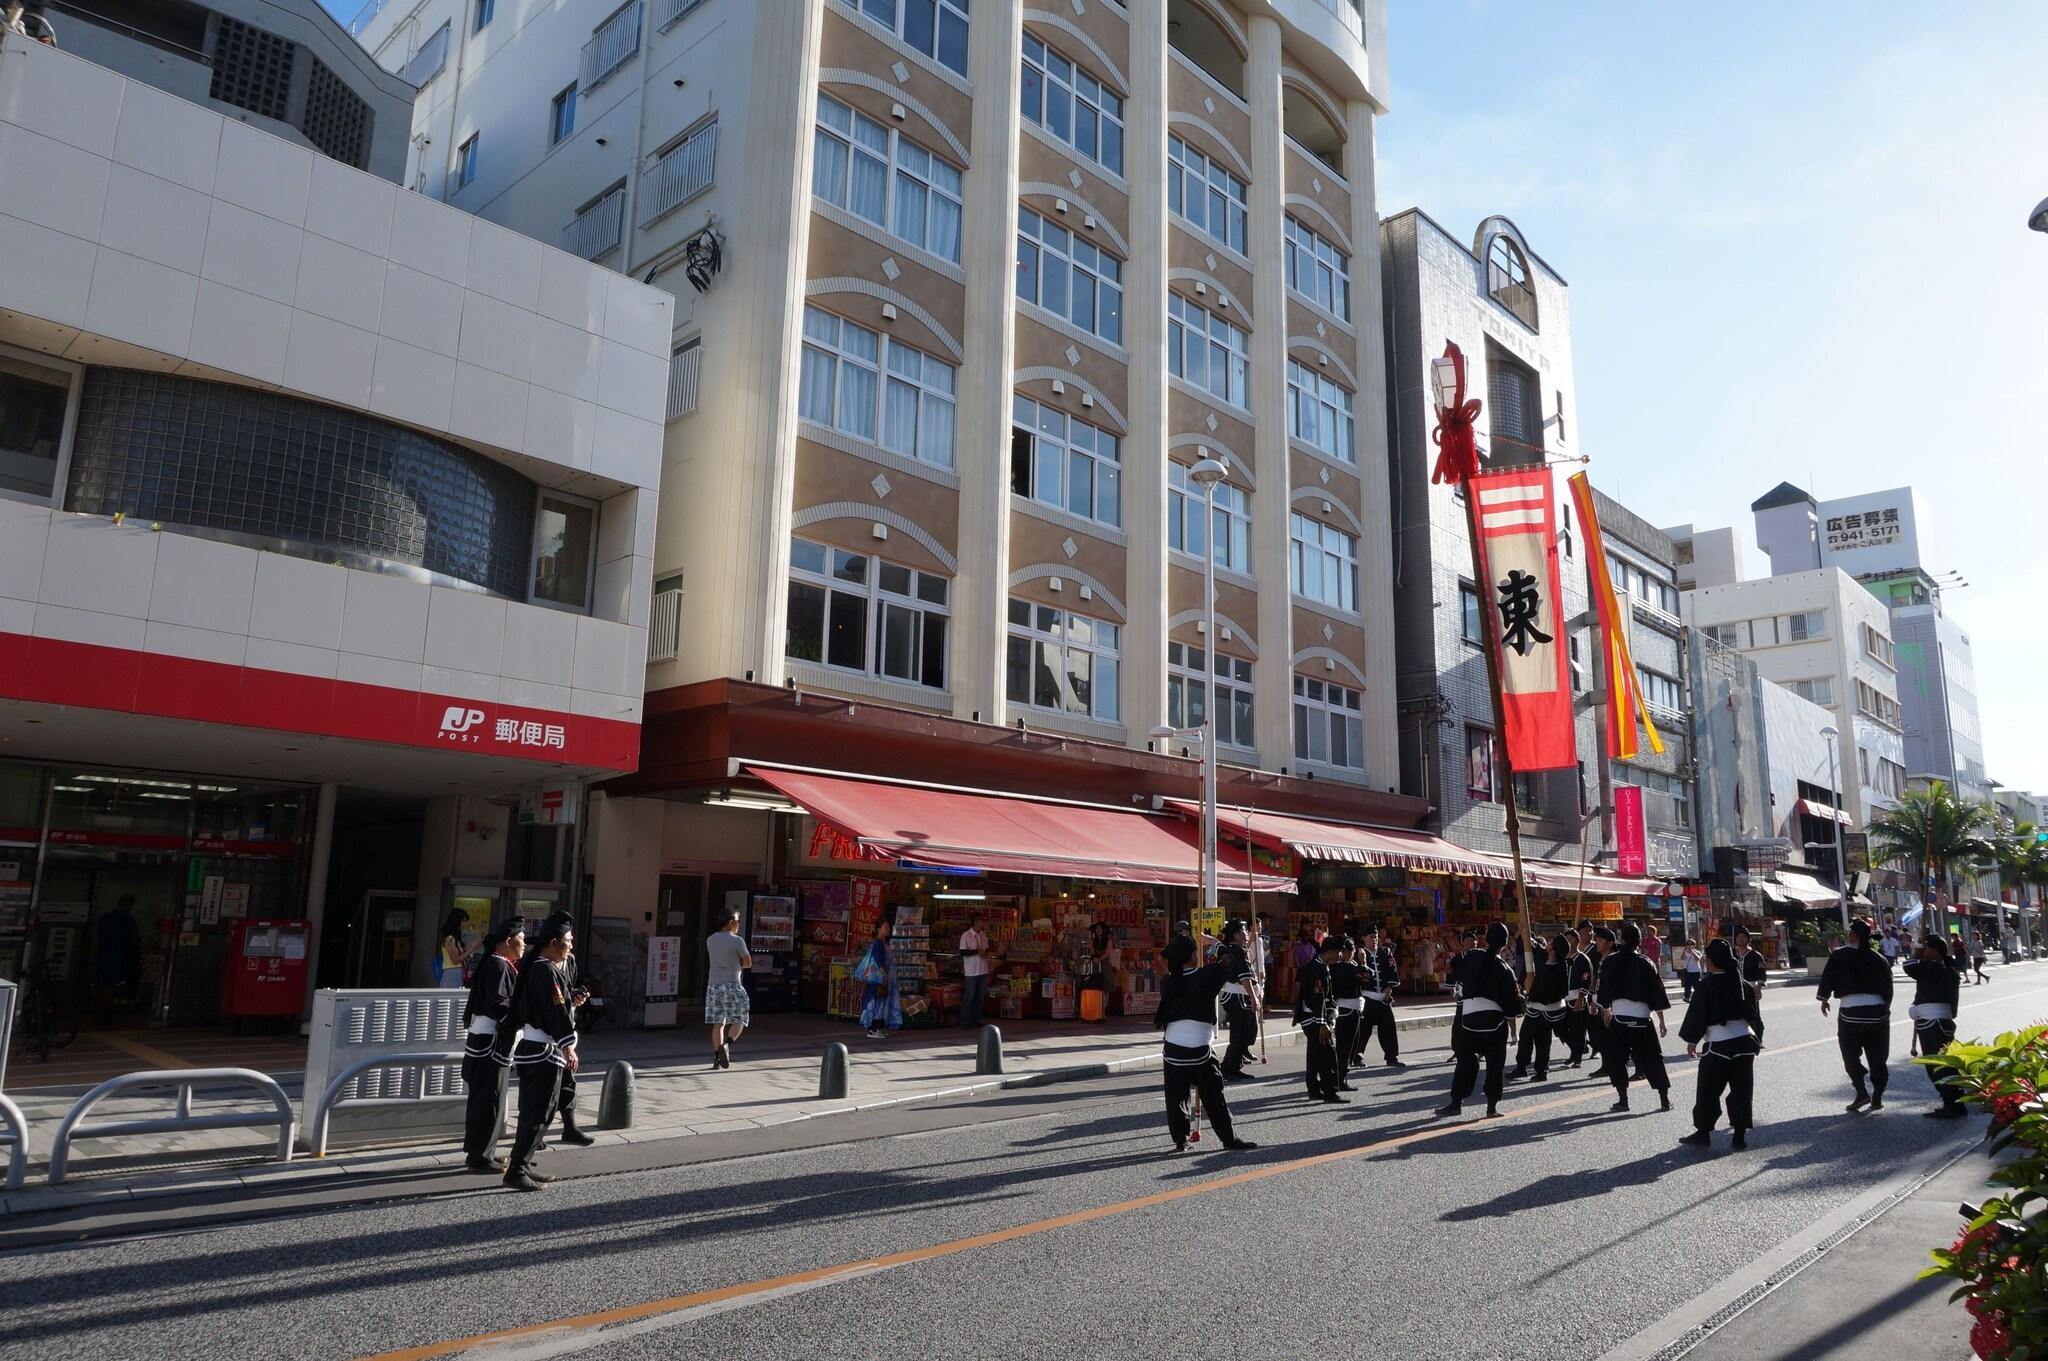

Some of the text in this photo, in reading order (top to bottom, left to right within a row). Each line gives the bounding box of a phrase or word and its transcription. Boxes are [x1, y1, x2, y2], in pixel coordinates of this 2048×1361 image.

[1826, 507, 1899, 532] 広告募集
[1497, 569, 1554, 657] 東
[437, 731, 479, 743] POST
[495, 718, 565, 749] 郵便局
